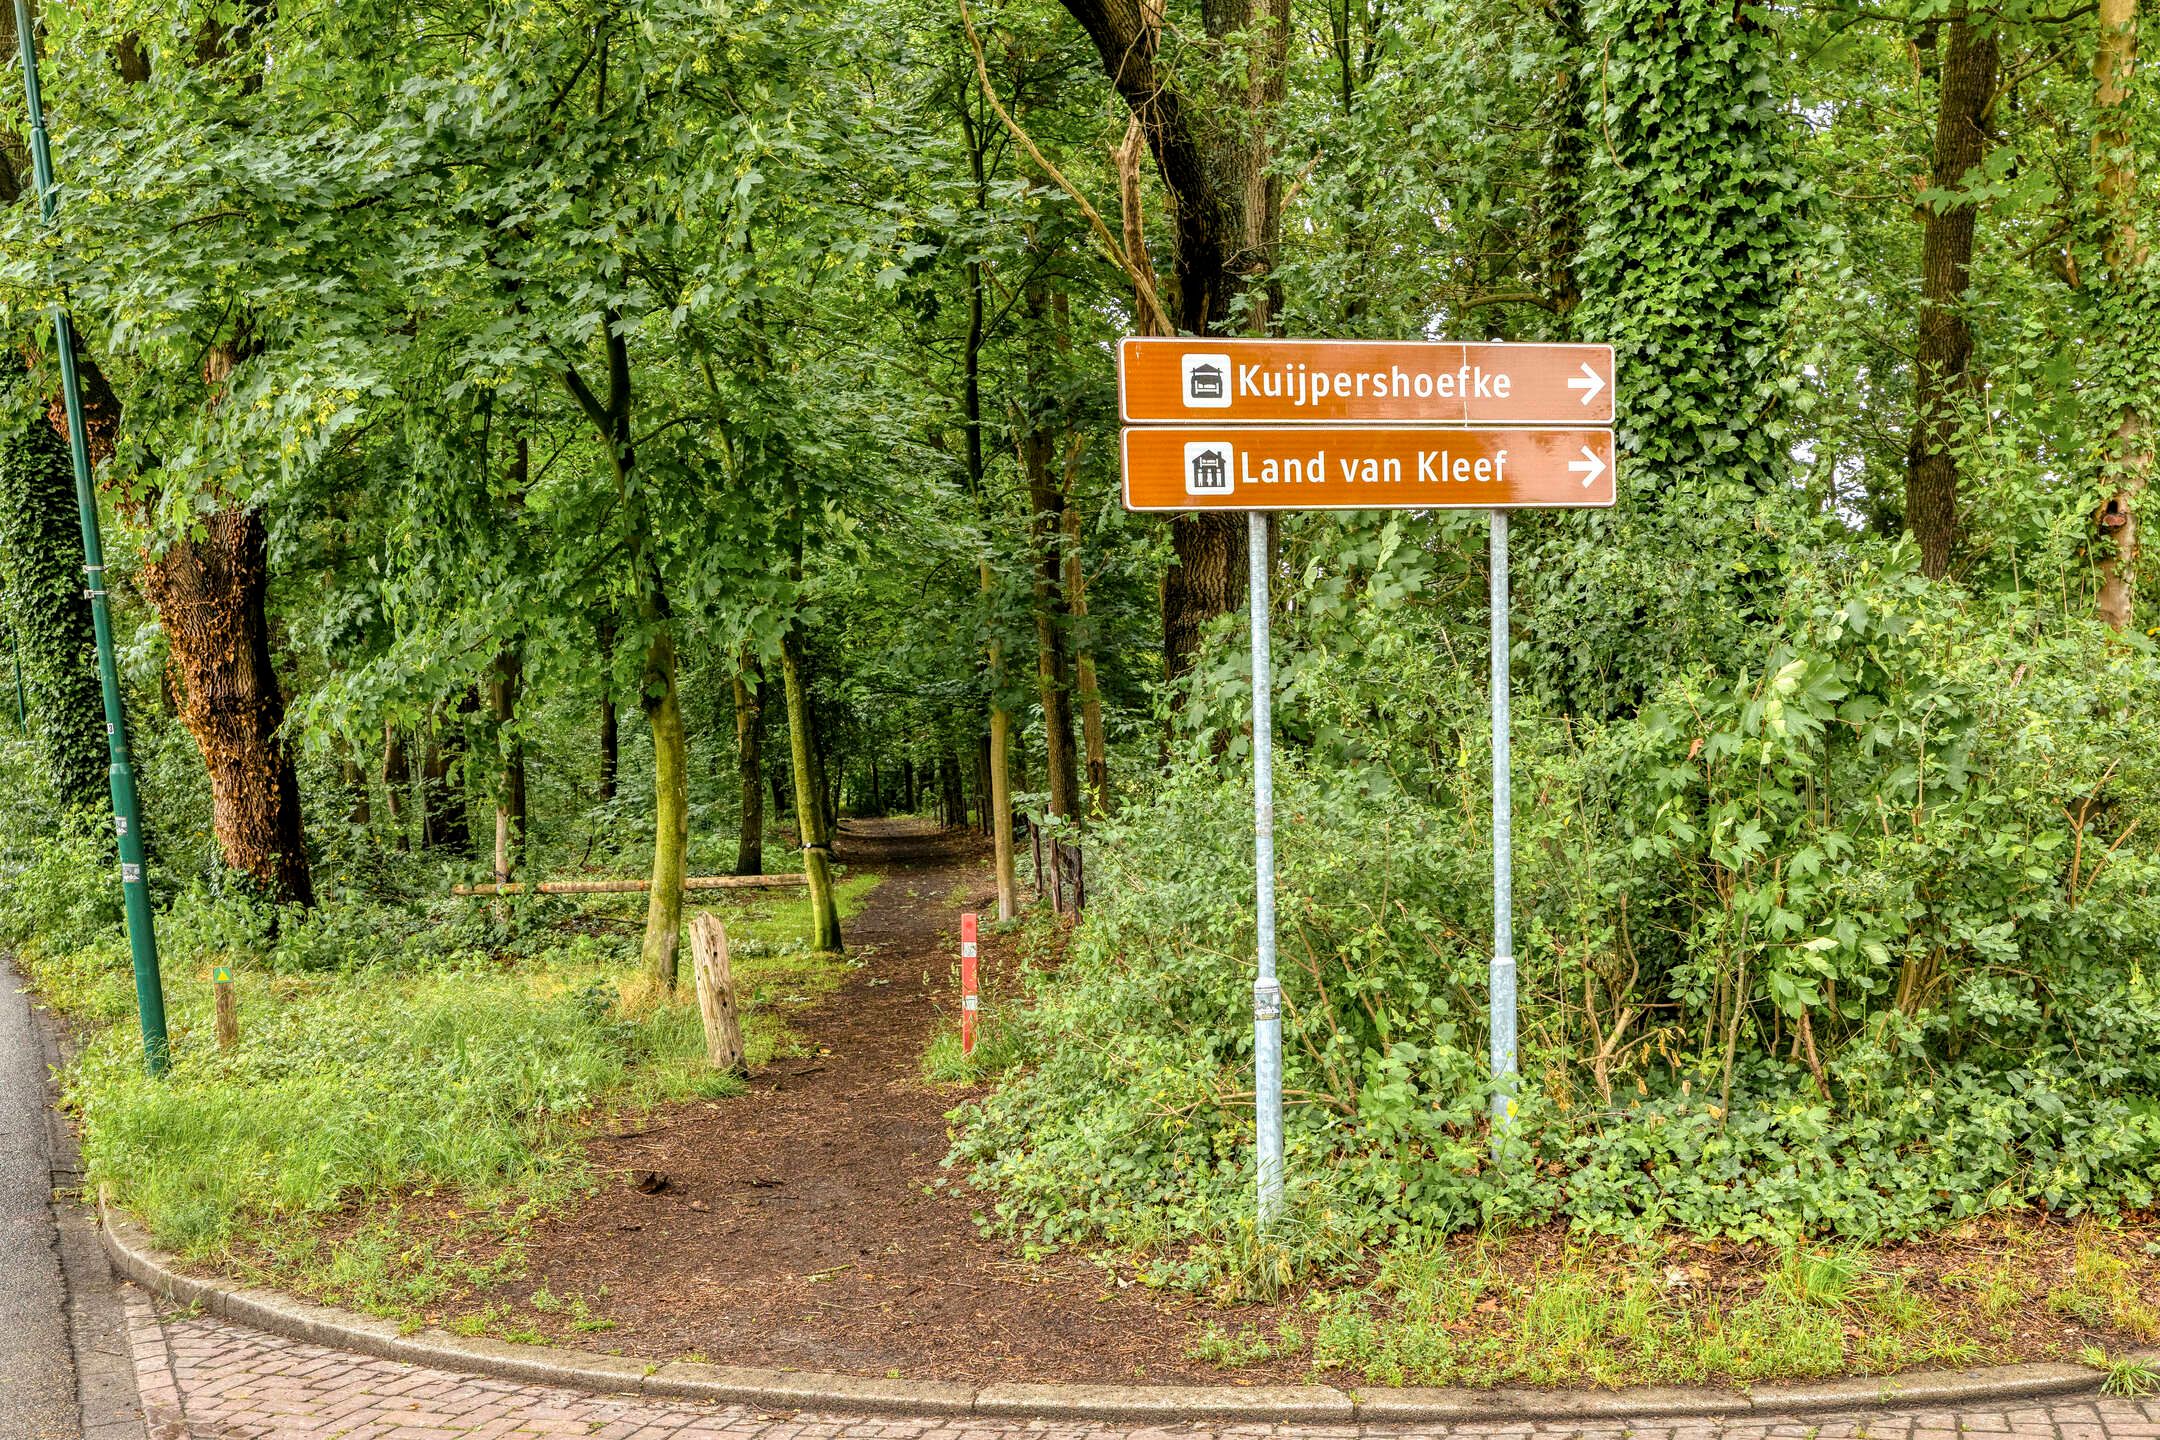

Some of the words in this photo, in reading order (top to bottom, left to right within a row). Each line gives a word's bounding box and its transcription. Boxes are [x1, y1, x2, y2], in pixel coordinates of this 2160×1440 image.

[1239, 363, 1511, 406] Kuijpershoefke
[1241, 450, 1325, 483] Land
[1339, 458, 1401, 483] van
[1418, 450, 1508, 482] Kleef
